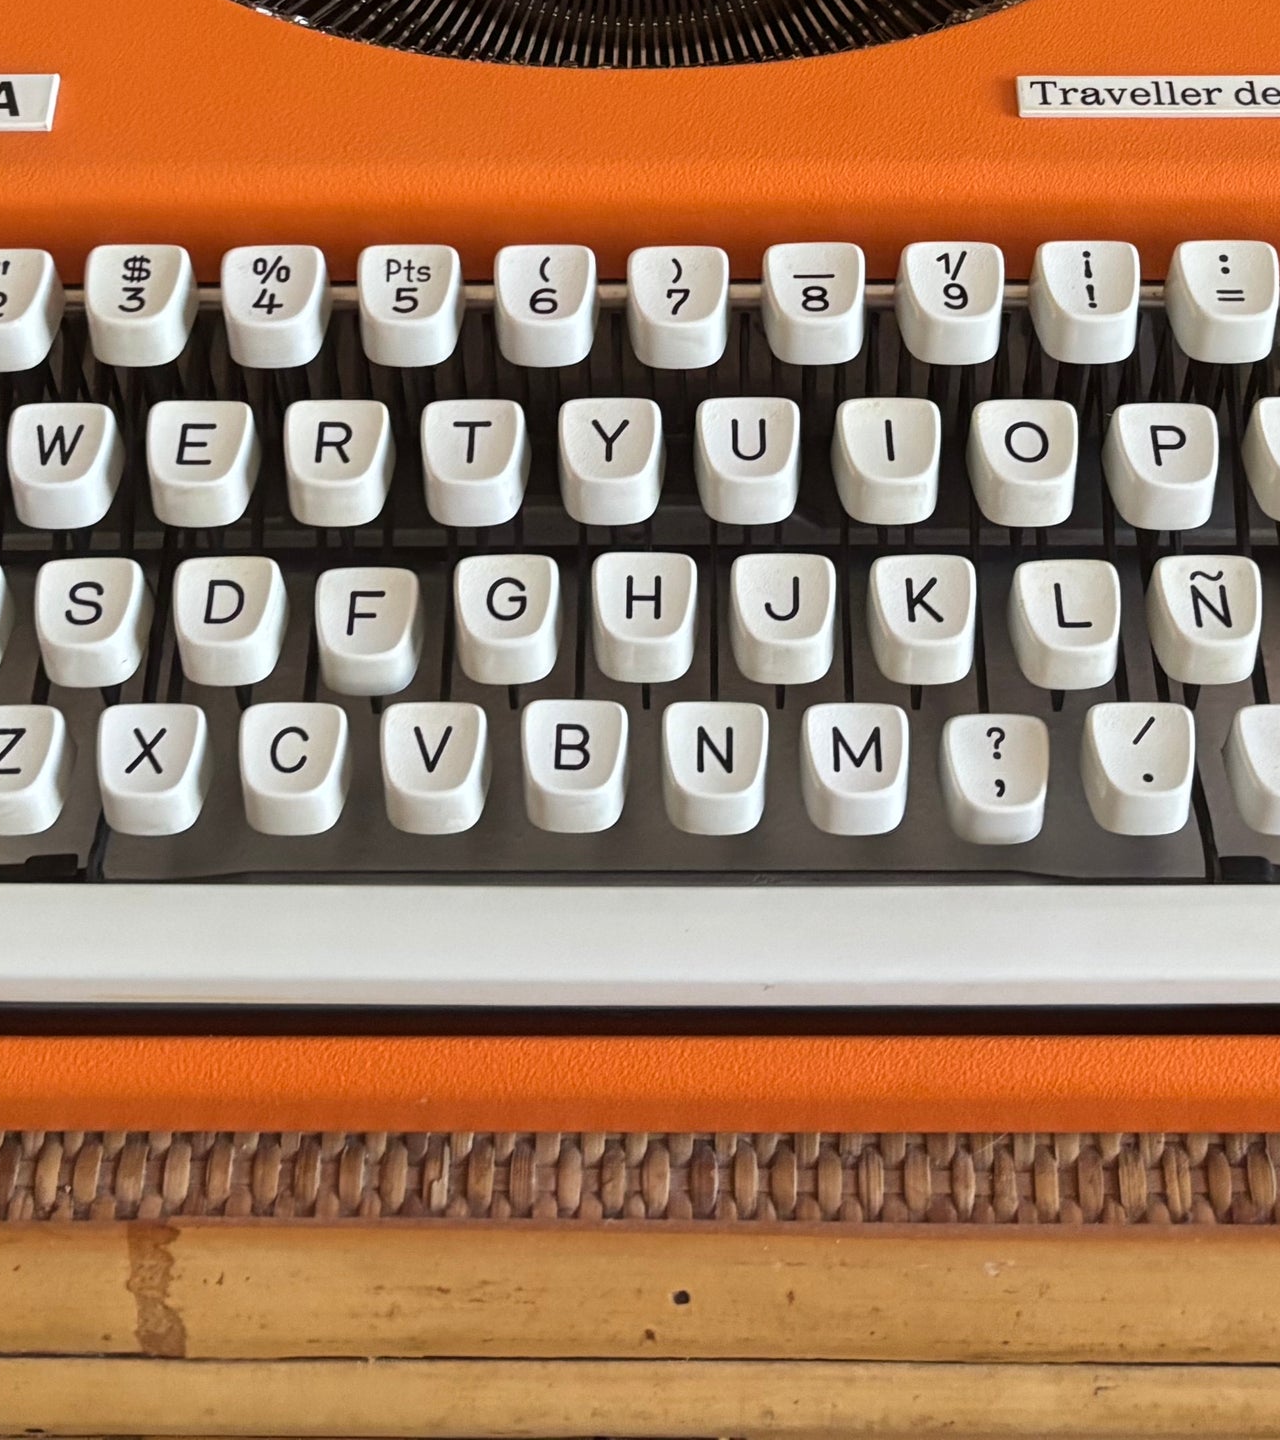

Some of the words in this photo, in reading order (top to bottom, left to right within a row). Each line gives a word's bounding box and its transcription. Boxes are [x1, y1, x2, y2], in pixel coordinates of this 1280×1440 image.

[1030, 81, 1222, 105] Traveller
[122, 256, 151, 282] $
[253, 256, 290, 284] %
[386, 259, 431, 282] Pts
[118, 287, 145, 312] 3
[252, 289, 283, 314] 4
[392, 288, 418, 313] 5
[530, 288, 558, 314] 6
[667, 289, 690, 315] 7
[802, 286, 829, 312] 8
[943, 283, 968, 310] 9
[37, 425, 84, 466] W
[176, 424, 217, 465] E
[315, 422, 352, 463] R
[453, 421, 492, 463] T
[592, 420, 629, 462] Y
[732, 419, 766, 461] U
[885, 420, 895, 461] I
[1005, 422, 1049, 463] O
[1150, 425, 1186, 466] P
[65, 582, 104, 625] S
[204, 580, 244, 624] D
[347, 591, 385, 635] F
[487, 577, 527, 621] G
[626, 575, 661, 619] H
[765, 576, 799, 621] J
[906, 577, 944, 622] K
[1054, 583, 1092, 628] L
[1190, 571, 1232, 628] Ñ
[125, 728, 166, 774] X
[270, 727, 309, 773] C
[414, 726, 452, 773] V
[554, 724, 590, 770] B
[697, 726, 733, 773] N
[832, 727, 882, 772] M
[987, 727, 1005, 759] ?
